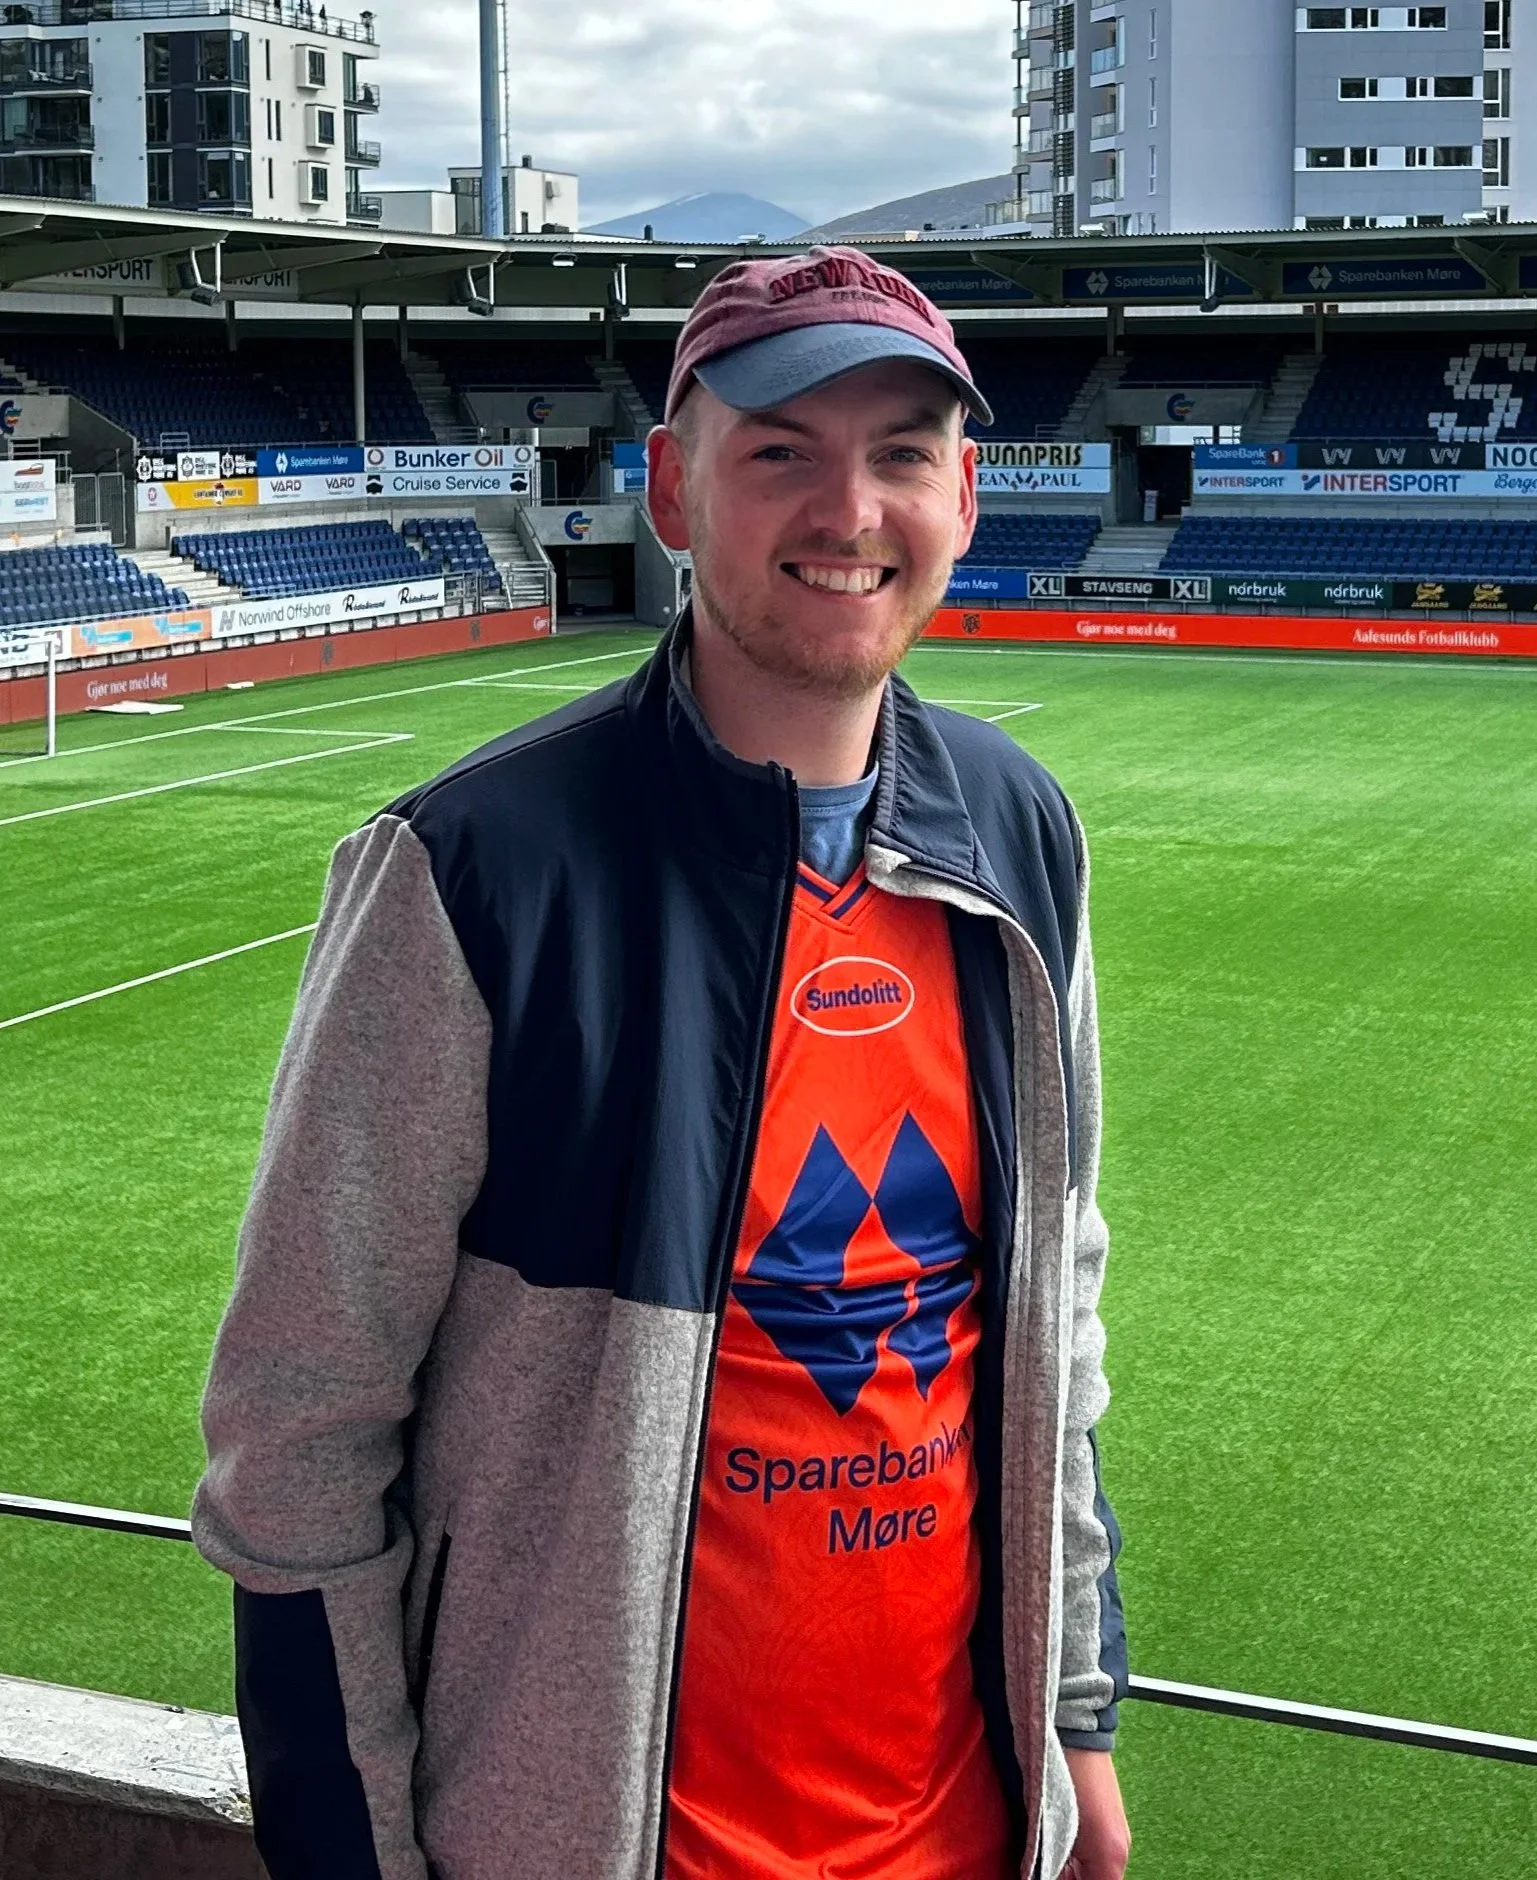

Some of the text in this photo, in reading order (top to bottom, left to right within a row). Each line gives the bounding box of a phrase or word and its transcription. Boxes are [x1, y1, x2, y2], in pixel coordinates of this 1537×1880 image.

[768, 257, 851, 305] NEW
[1114, 275, 1194, 290] Sparebanken
[1338, 268, 1461, 284] Sparebanken Møre
[394, 448, 504, 468] Bunker Oil
[1208, 447, 1266, 460] SpareBank
[270, 479, 302, 493] VARD
[325, 476, 355, 490] VARD
[392, 474, 501, 492] Cruise Service
[977, 472, 1082, 487] EAN PAUL
[1209, 476, 1285, 488] INTERSPORT
[1323, 473, 1461, 493] INTERSPORT
[1031, 577, 1061, 595] XL
[1082, 581, 1153, 595] STAVSENG
[1174, 580, 1206, 600] XL
[238, 606, 285, 627] Norwind
[286, 603, 332, 621] Offshore
[1076, 620, 1178, 640] Gjør noe med deg
[1352, 627, 1500, 648] Aalesunds Fotballklubb
[86, 671, 168, 699] Gjør noe med deg
[806, 978, 902, 1012] Sundolitt
[828, 1503, 937, 1555] Møre
